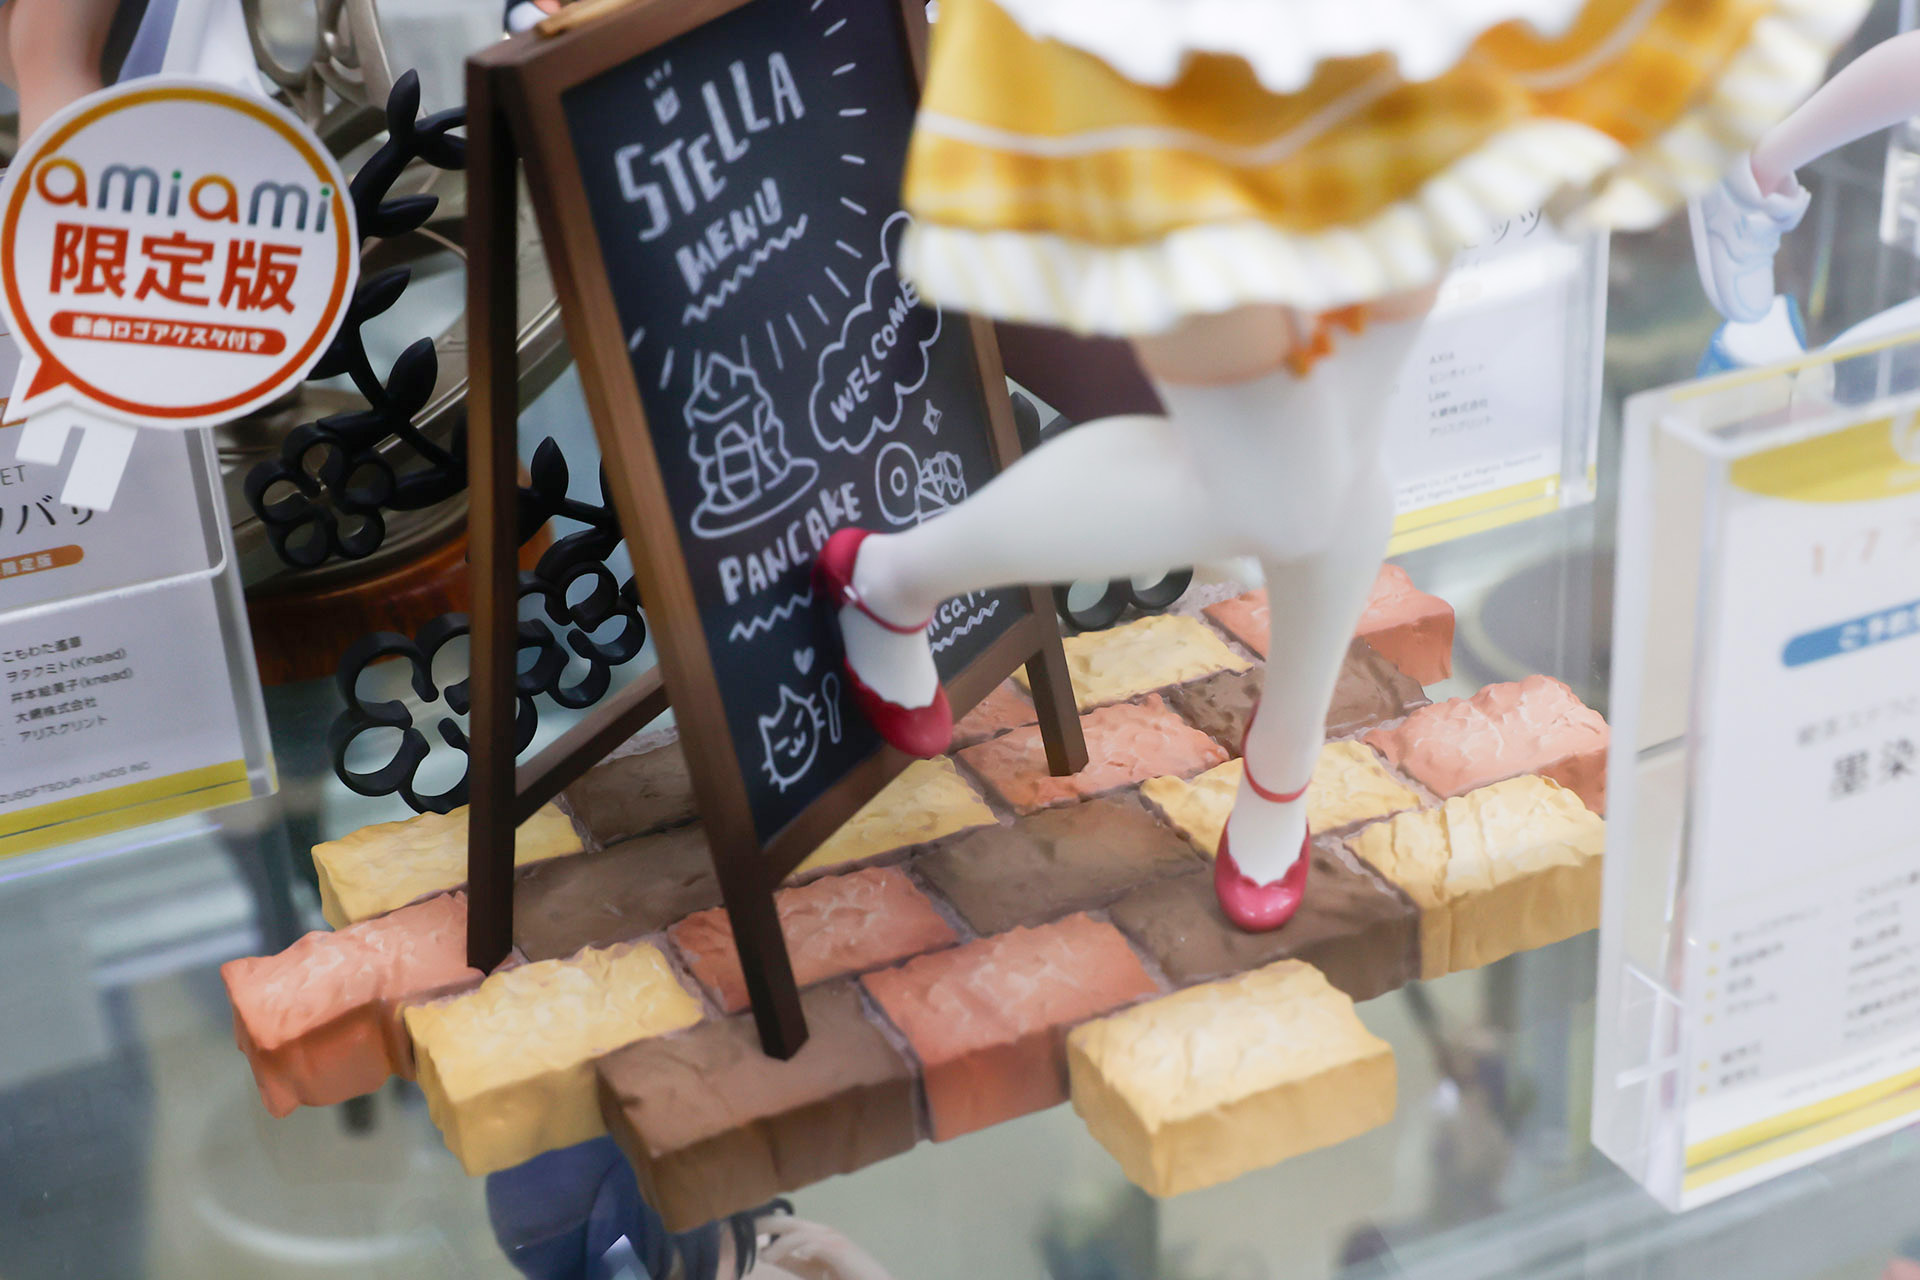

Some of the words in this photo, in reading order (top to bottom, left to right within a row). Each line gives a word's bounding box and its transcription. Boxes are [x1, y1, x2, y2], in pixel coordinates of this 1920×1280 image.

[36, 157, 332, 233] amiami
[614, 52, 806, 242] STELLA
[50, 221, 303, 315] 限定版
[674, 177, 784, 294] MENU
[829, 277, 920, 424] WELCOME
[718, 482, 863, 605] PANCAKE
